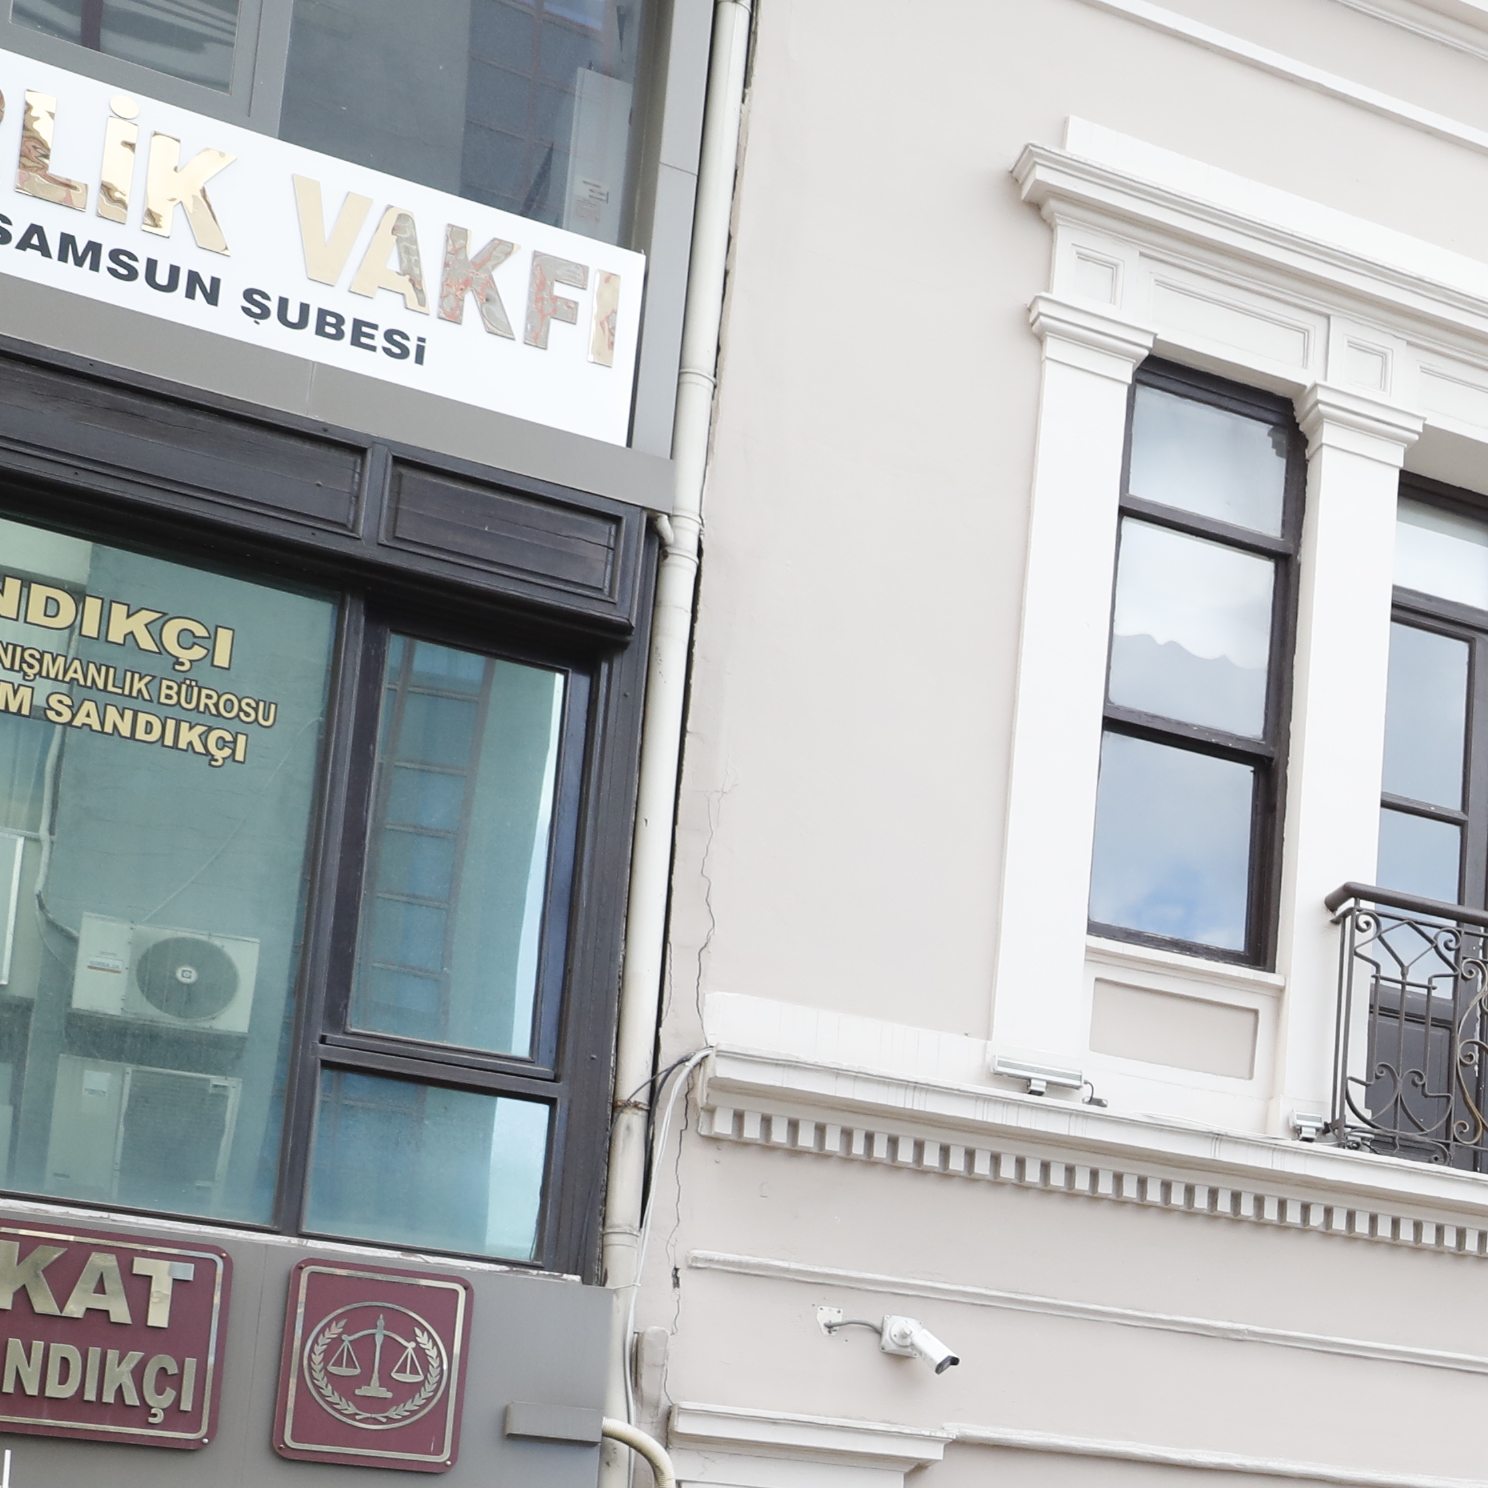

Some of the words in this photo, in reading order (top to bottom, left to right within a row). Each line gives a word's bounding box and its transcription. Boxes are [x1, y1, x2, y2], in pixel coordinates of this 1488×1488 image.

[0, 88, 237, 257] LİK
[292, 174, 621, 367] VAKFI
[44, 692, 248, 768] SANDIKÇI
[158, 677, 278, 728] BÜROSU
[0, 1239, 195, 1329] KAT
[2, 1338, 197, 1425] NDIKÇI
